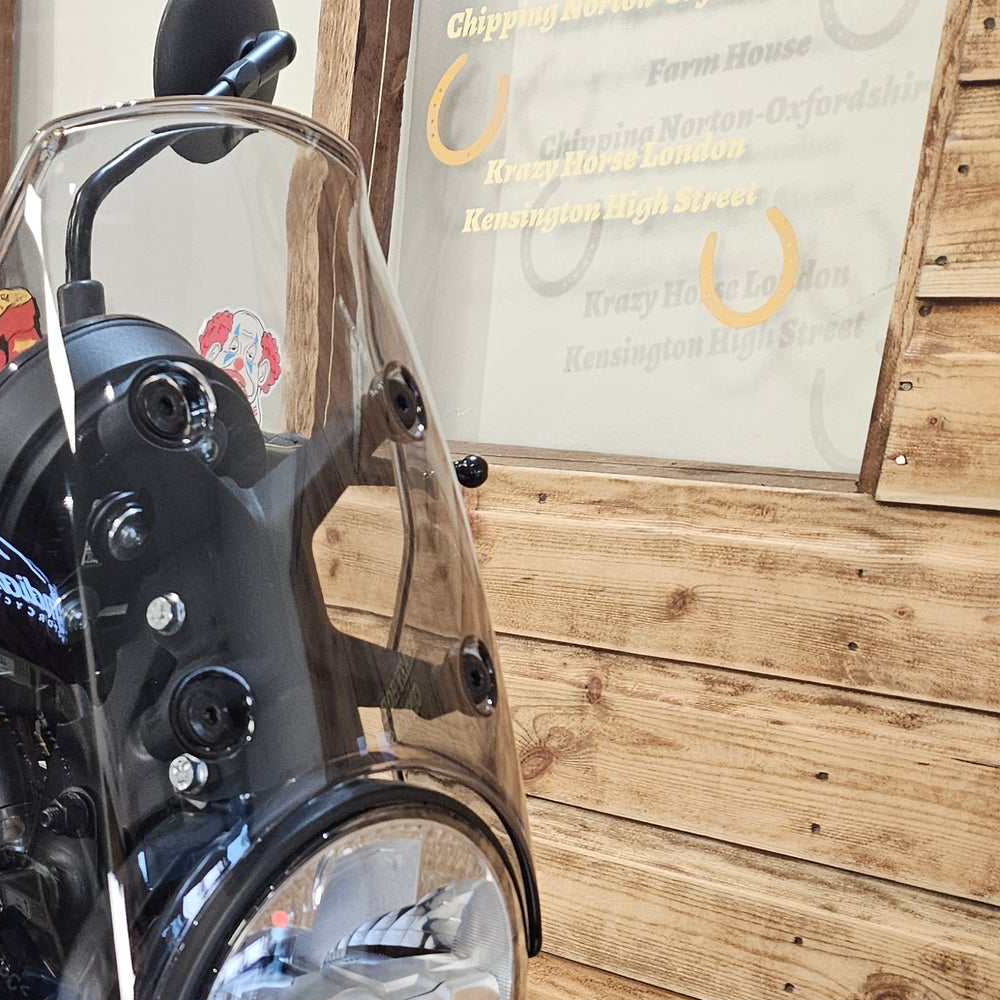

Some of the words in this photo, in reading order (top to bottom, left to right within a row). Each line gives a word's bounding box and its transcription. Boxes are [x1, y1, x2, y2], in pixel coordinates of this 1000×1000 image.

[447, 2, 558, 42] Chipping
[645, 56, 721, 88] Farm
[723, 35, 812, 73] House
[656, 70, 930, 143] Norton-Oxfordshir
[484, 159, 561, 187] Krazy
[561, 150, 638, 177] Horse
[639, 131, 746, 168] London
[461, 201, 602, 234] Kensington
[602, 186, 671, 225] High
[672, 181, 760, 214] Street
[583, 288, 660, 320] Krazy
[661, 276, 740, 308] Hose
[742, 258, 851, 299] Lodon
[563, 337, 703, 374] Kensington
[707, 321, 774, 361] High
[778, 312, 867, 348] Street
